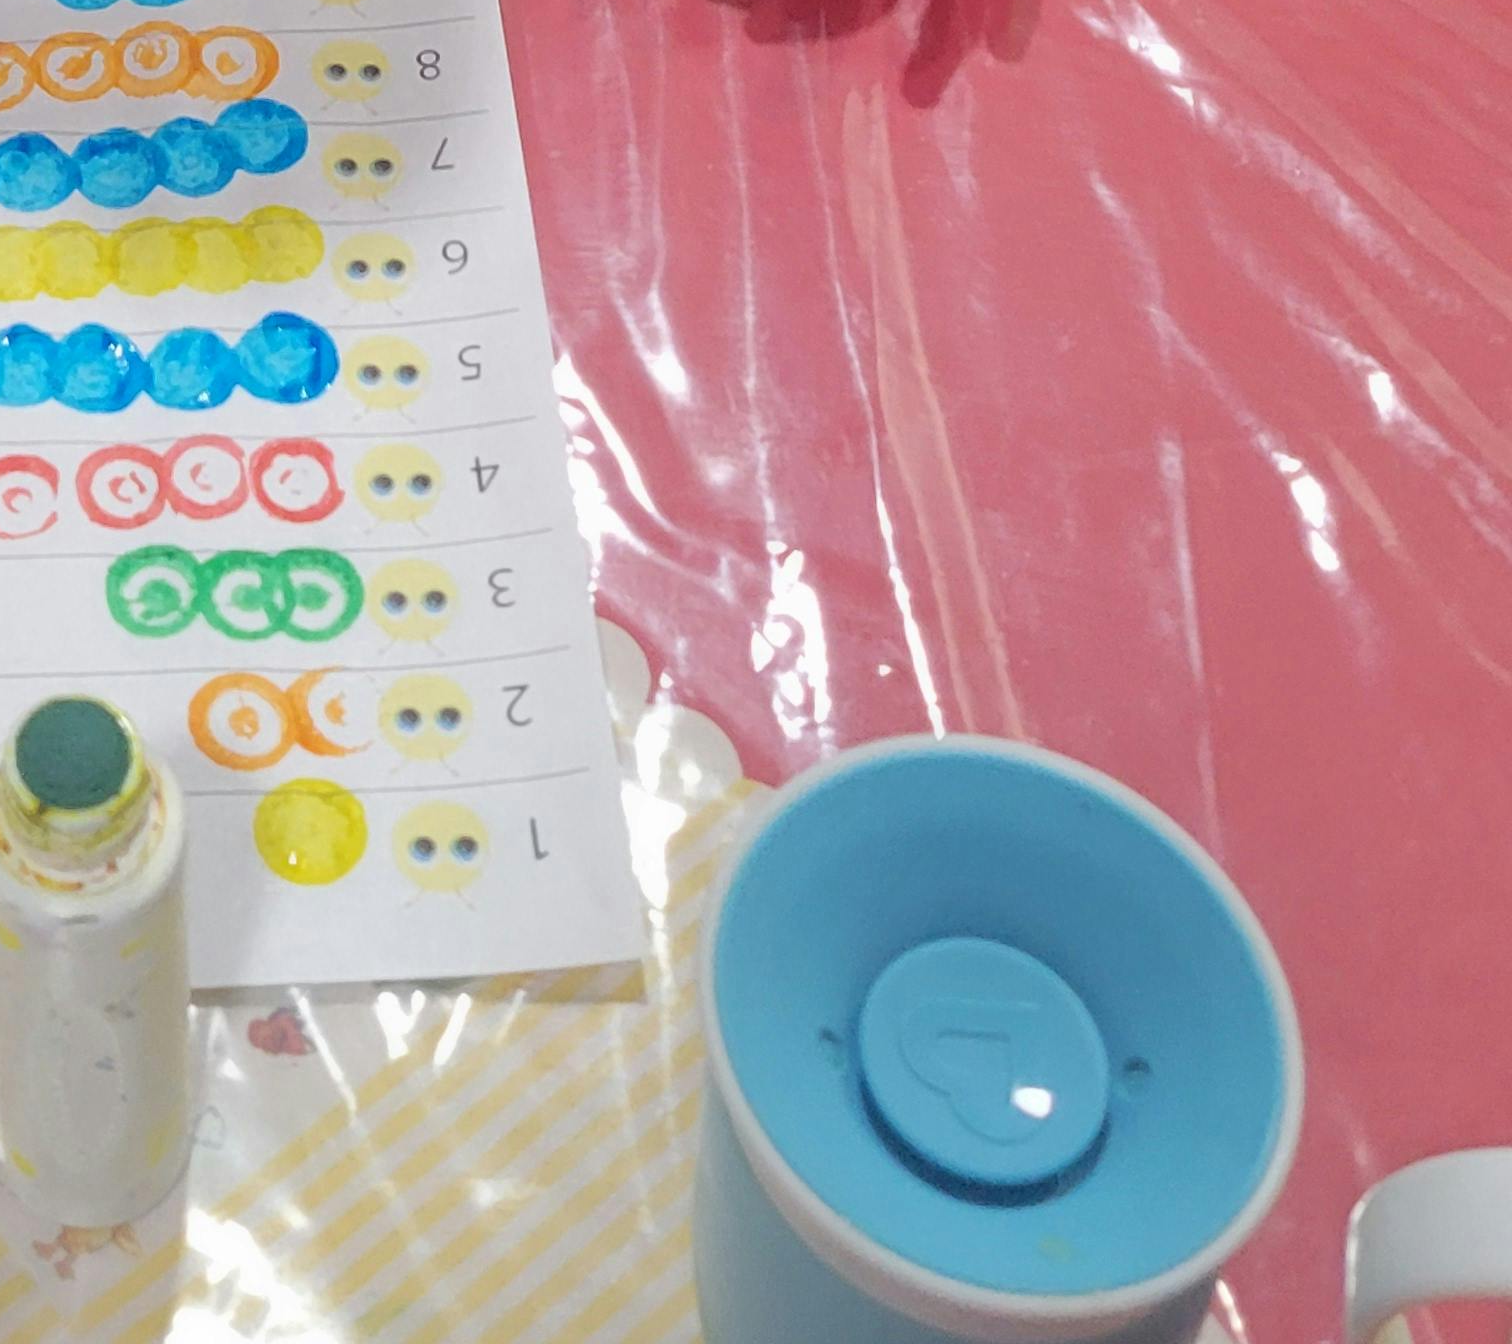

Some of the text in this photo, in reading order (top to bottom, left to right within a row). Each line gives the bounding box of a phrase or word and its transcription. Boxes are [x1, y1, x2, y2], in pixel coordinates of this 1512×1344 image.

[415, 49, 442, 82] 8
[430, 136, 455, 171] 7
[441, 239, 469, 275] 6
[457, 344, 483, 382] 5
[470, 456, 500, 494] 4
[487, 567, 516, 608] 3
[501, 684, 534, 728] 2
[530, 816, 549, 862] 1
